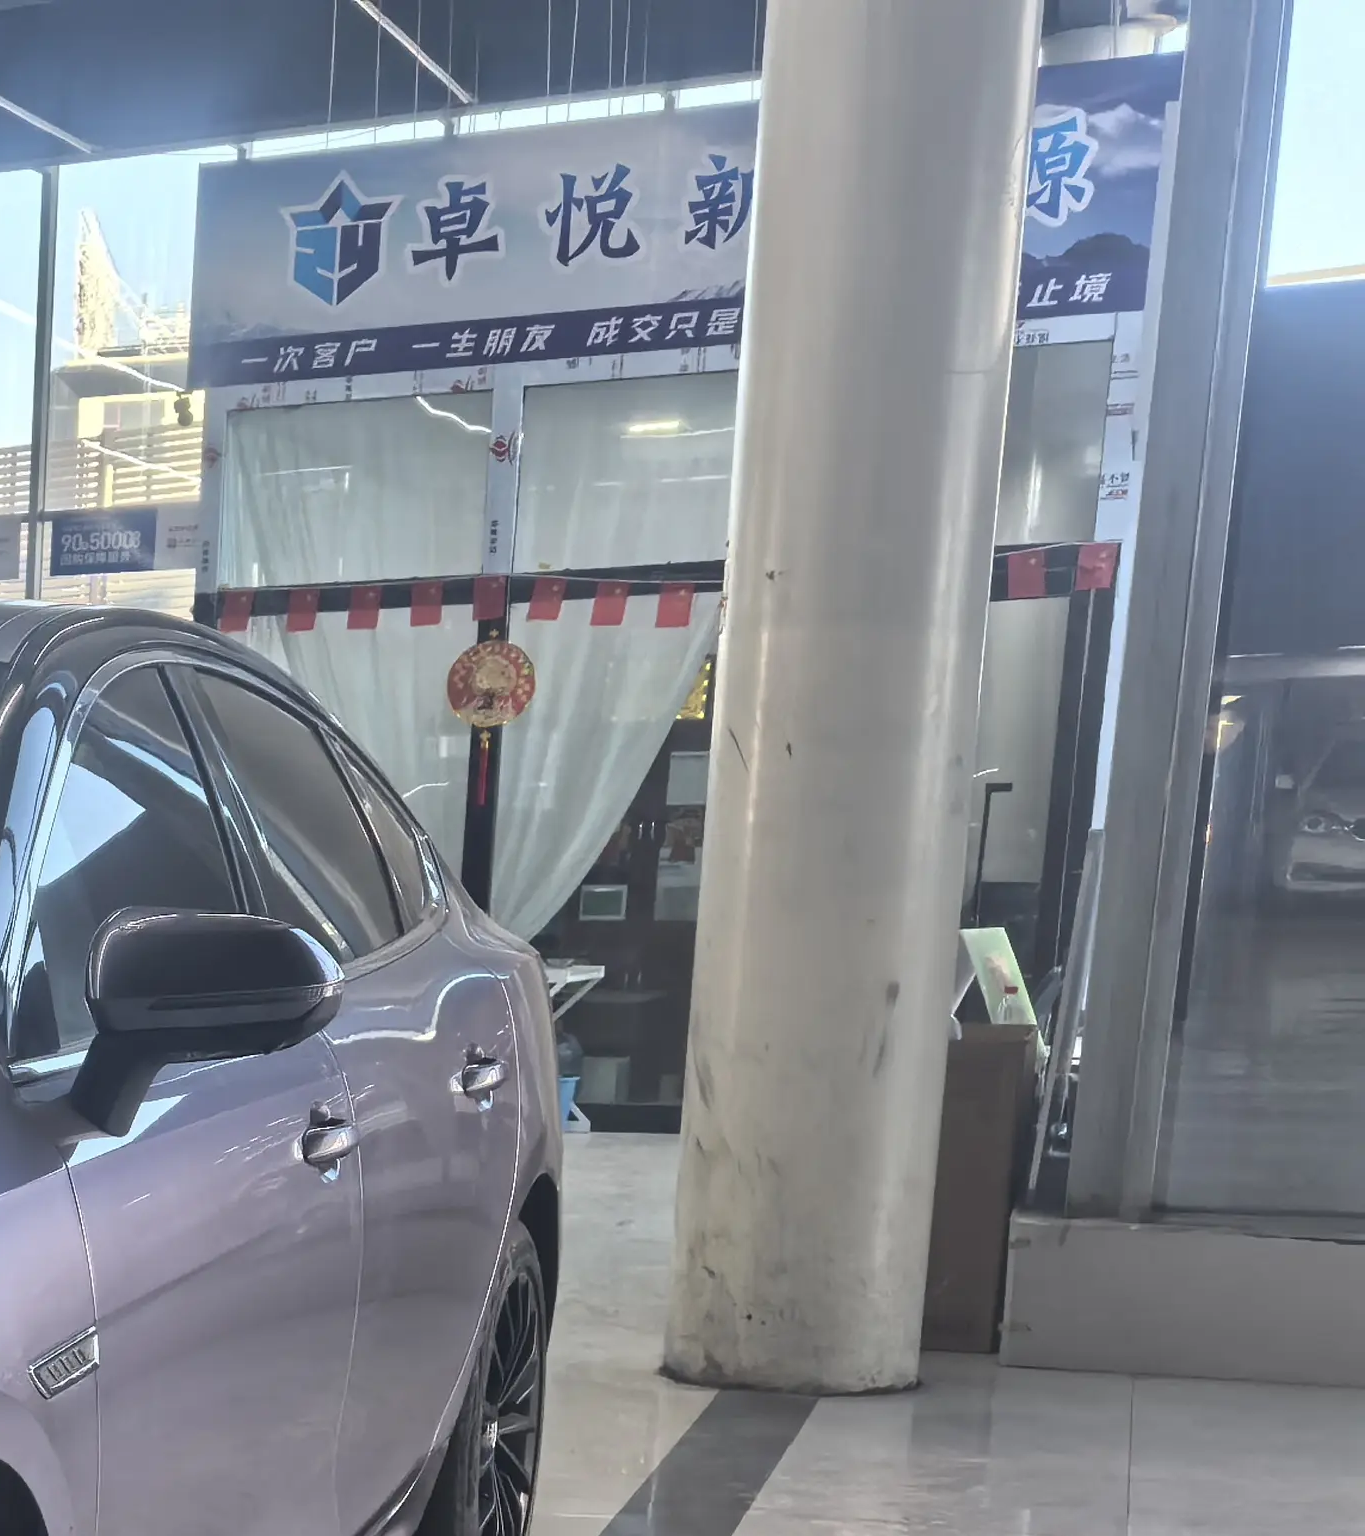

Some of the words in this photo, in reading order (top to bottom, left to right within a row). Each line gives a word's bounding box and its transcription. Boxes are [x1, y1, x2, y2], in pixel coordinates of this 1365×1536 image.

[241, 338, 378, 374] 一次客户
[411, 324, 556, 360] 一生朋友
[585, 307, 741, 347] 成交只是
[1019, 273, 1112, 307] 止境
